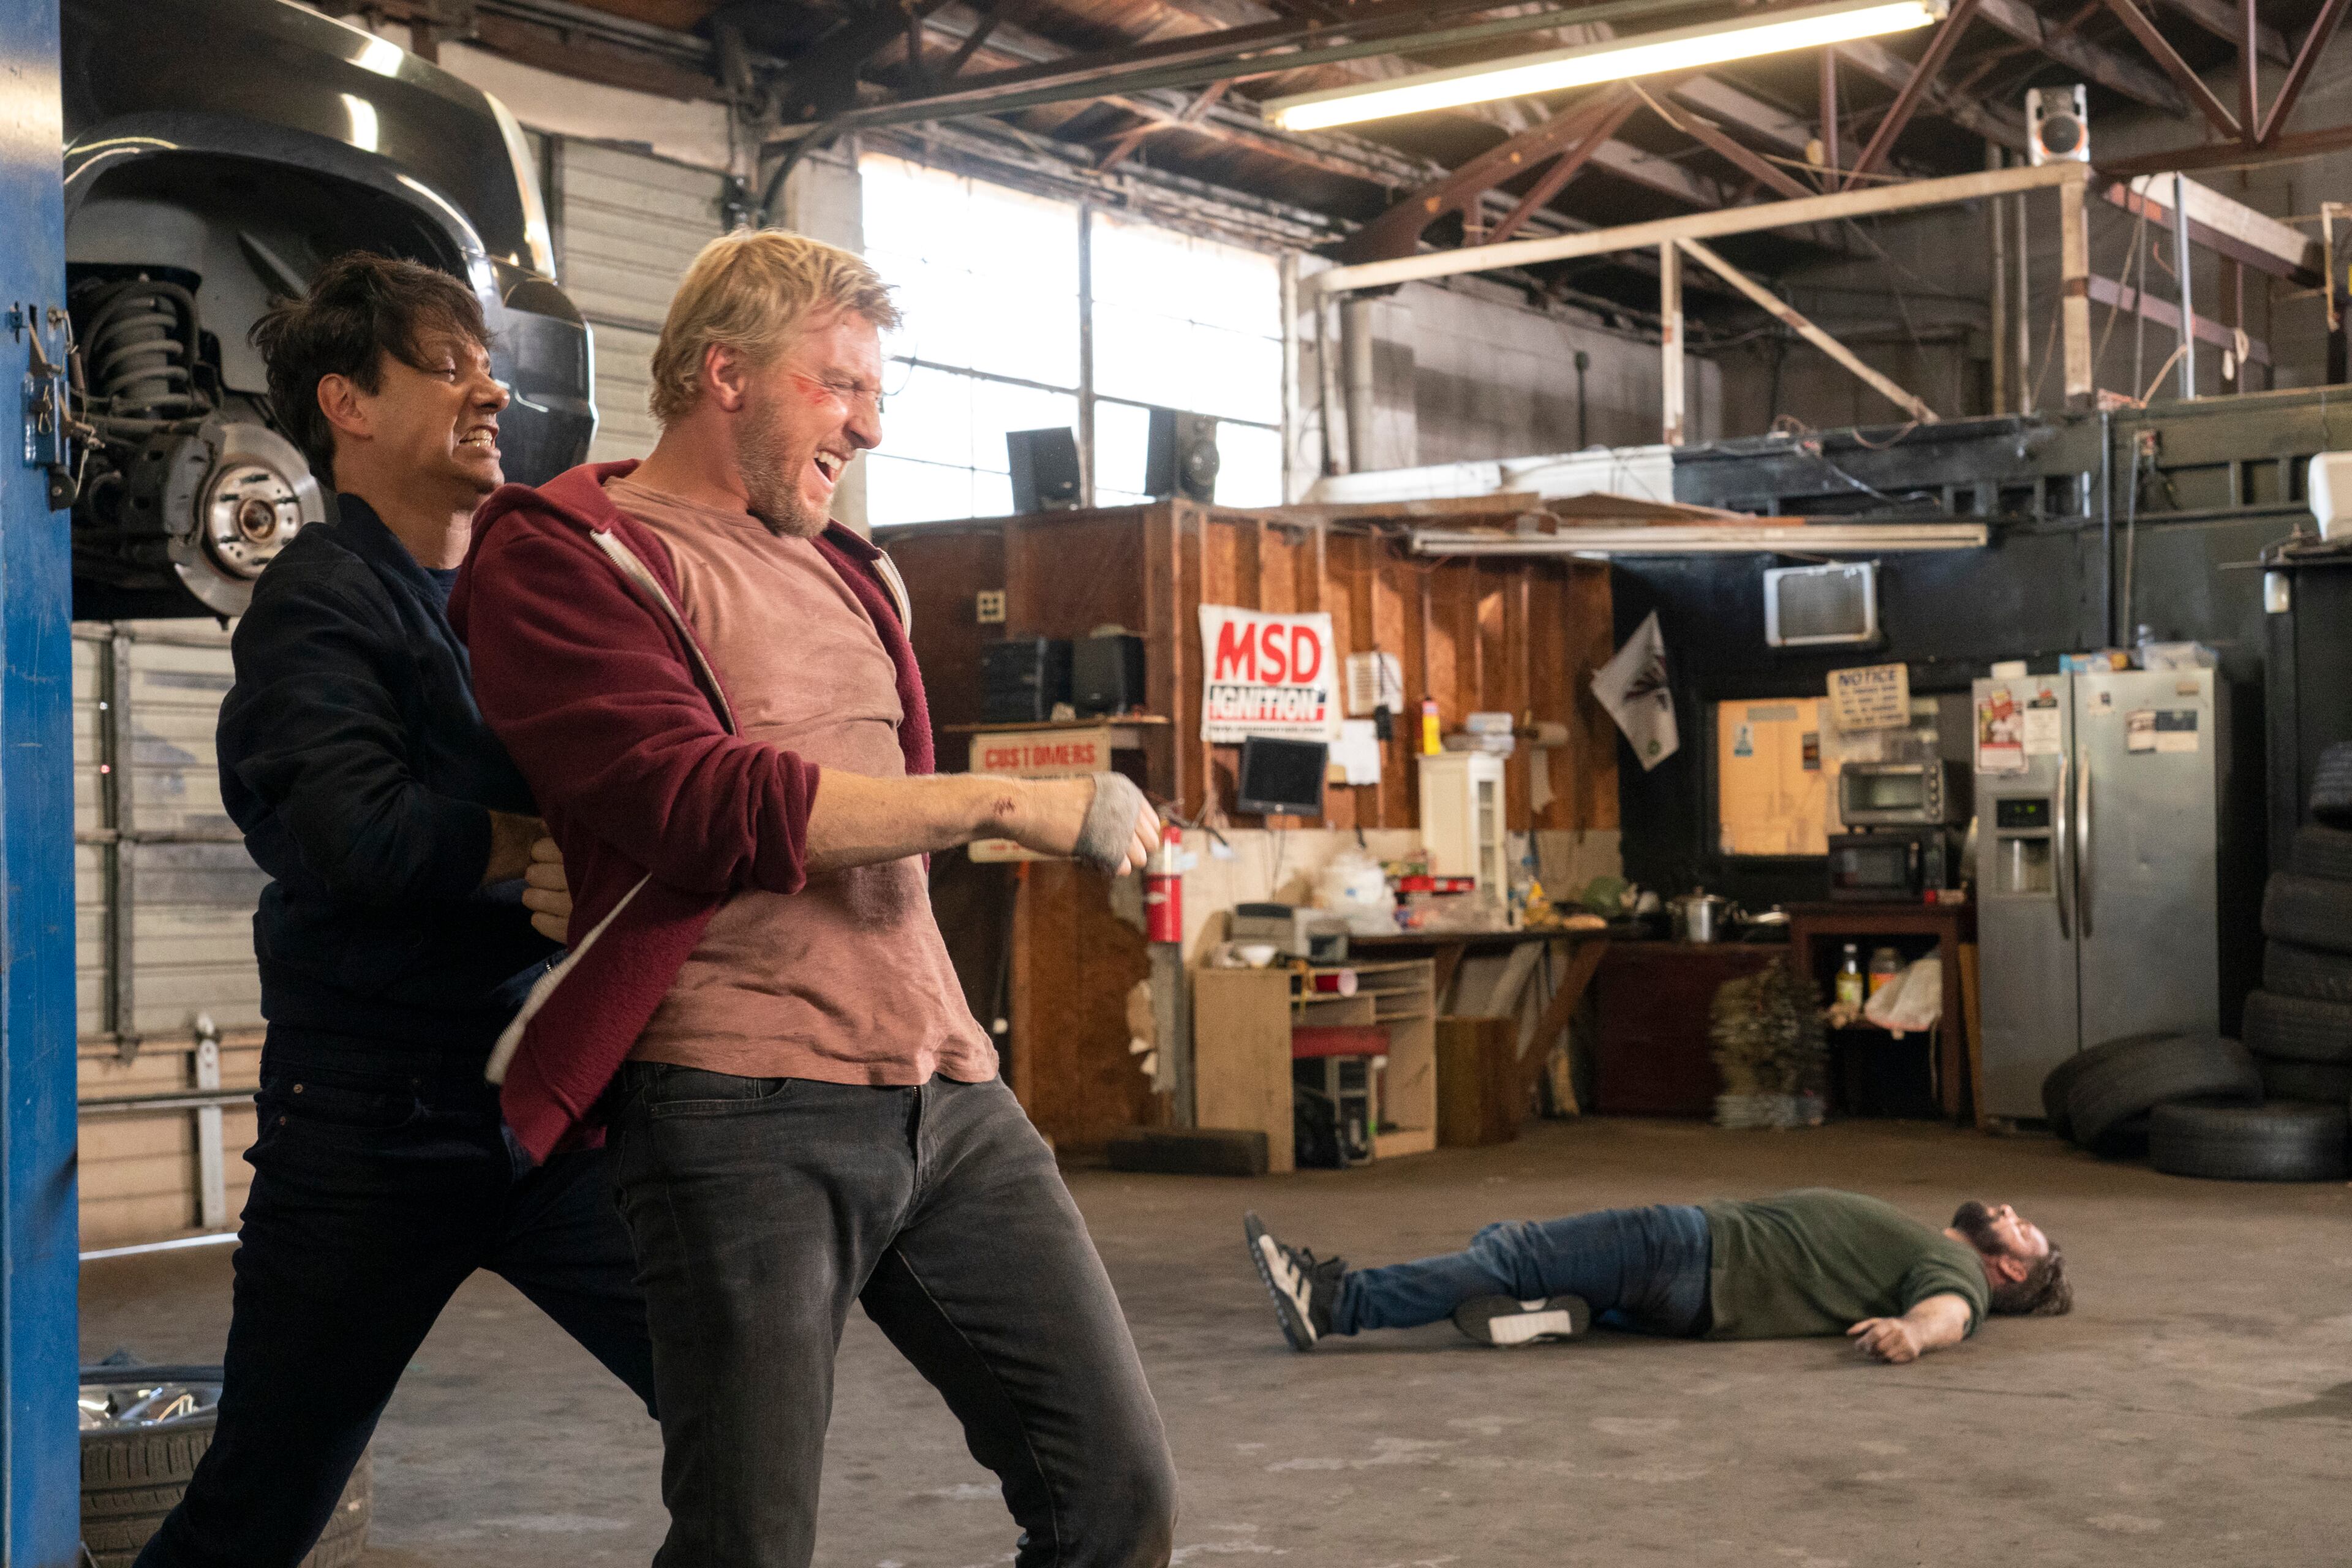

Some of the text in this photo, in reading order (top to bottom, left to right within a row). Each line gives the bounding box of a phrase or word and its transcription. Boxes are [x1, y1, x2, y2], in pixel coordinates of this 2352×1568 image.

[1215, 620, 1322, 684] MSD
[1838, 669, 1896, 686] NOTICE
[1211, 685, 1319, 721] IGNITION
[985, 744, 1095, 769] CUSTOMERS
